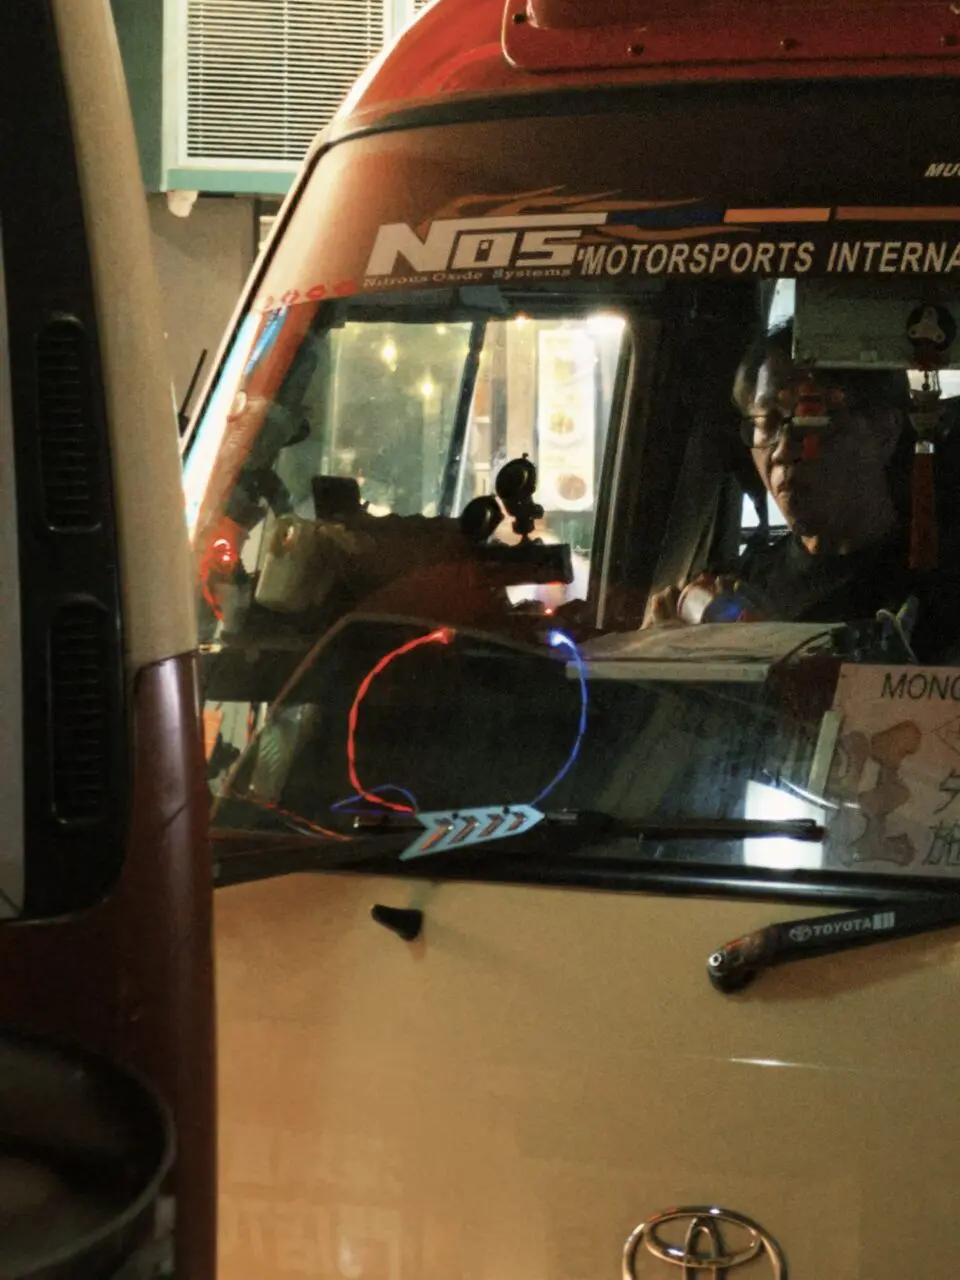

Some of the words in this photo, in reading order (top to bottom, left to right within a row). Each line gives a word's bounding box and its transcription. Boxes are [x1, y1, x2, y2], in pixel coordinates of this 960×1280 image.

[364, 211, 609, 277] NOS
[580, 241, 815, 276] MOTORSPORTS
[432, 271, 484, 283] Oxide
[492, 267, 572, 281] Systems
[812, 916, 872, 937] TOYOTA
